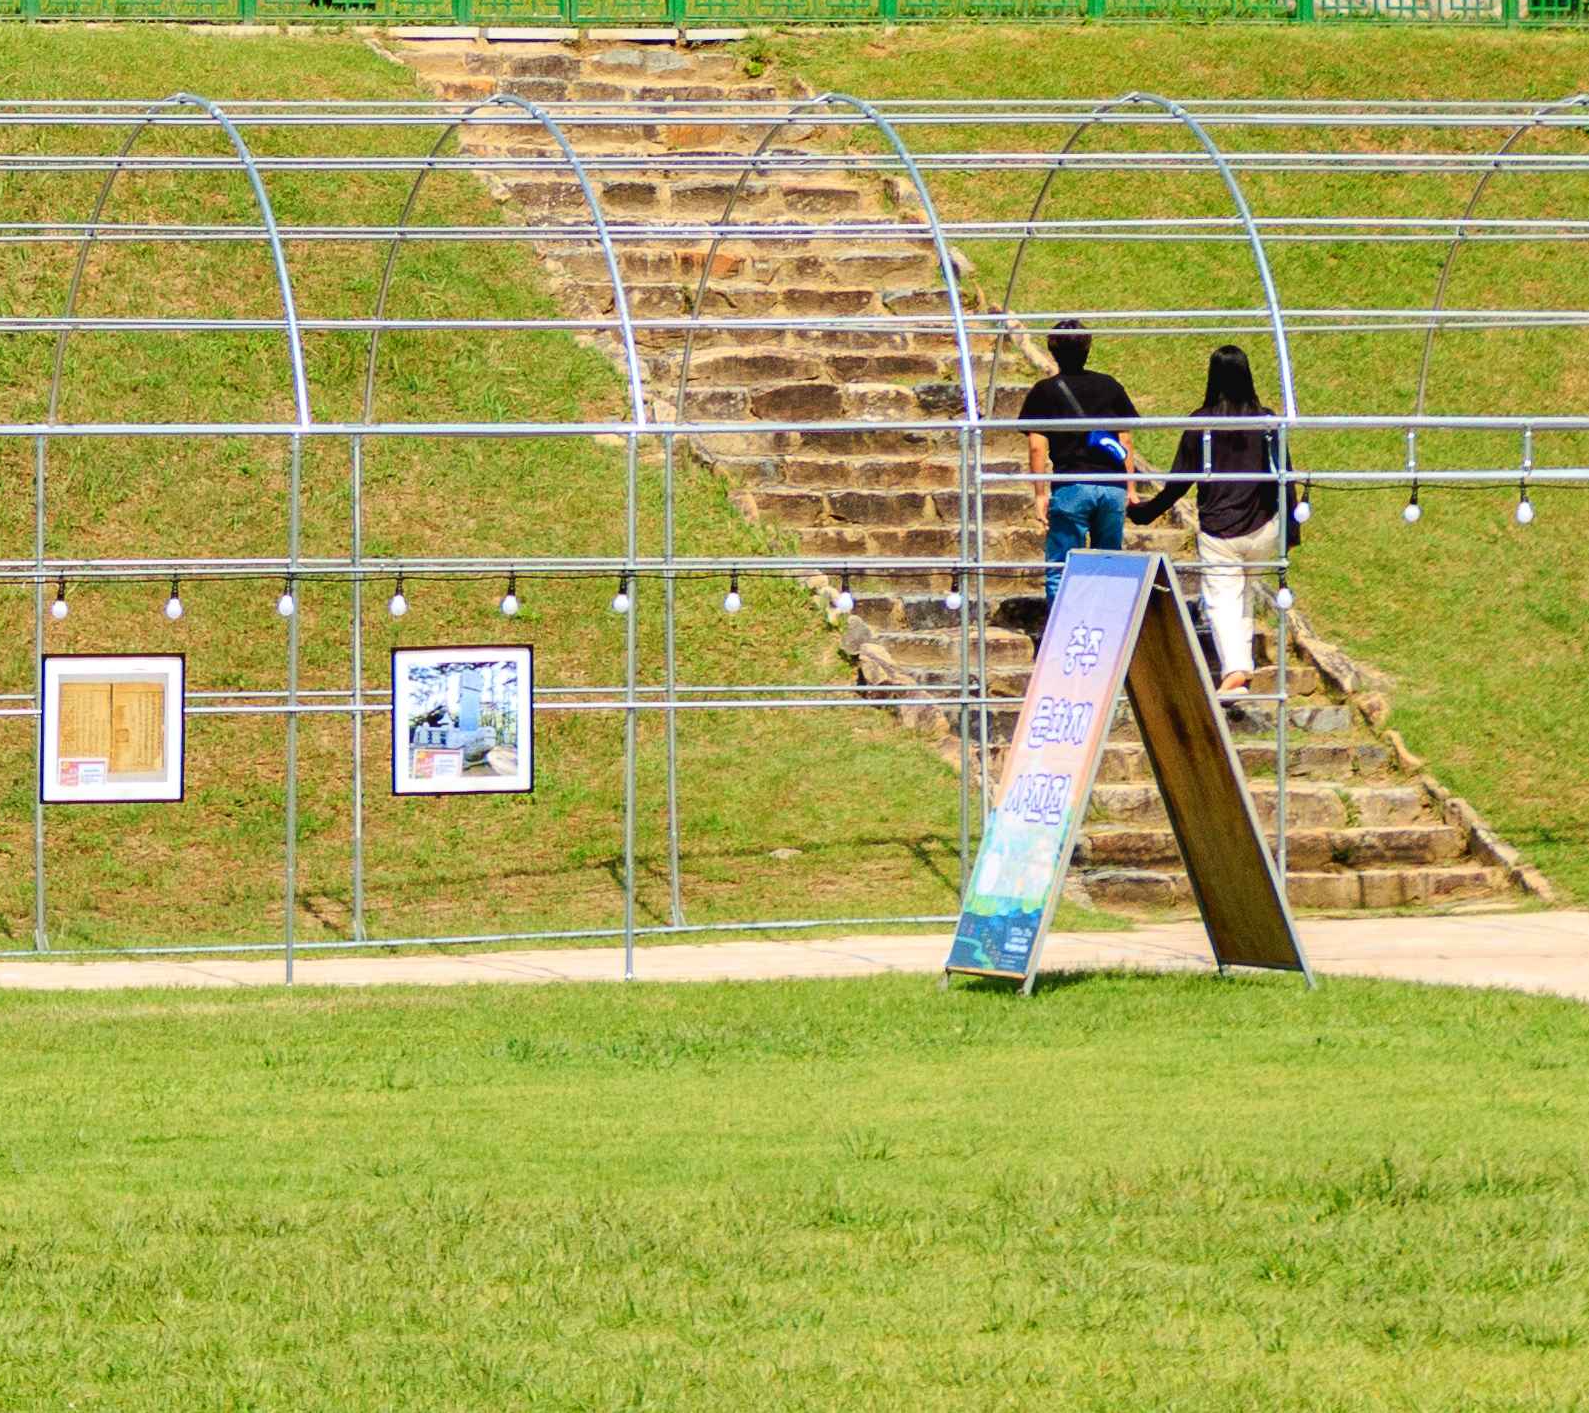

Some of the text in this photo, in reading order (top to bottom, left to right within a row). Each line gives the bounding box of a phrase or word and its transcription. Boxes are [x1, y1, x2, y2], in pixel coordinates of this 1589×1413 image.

[1063, 622, 1104, 675] 충주
[1028, 696, 1093, 748] 문화재
[1005, 774, 1071, 825] 사진전
